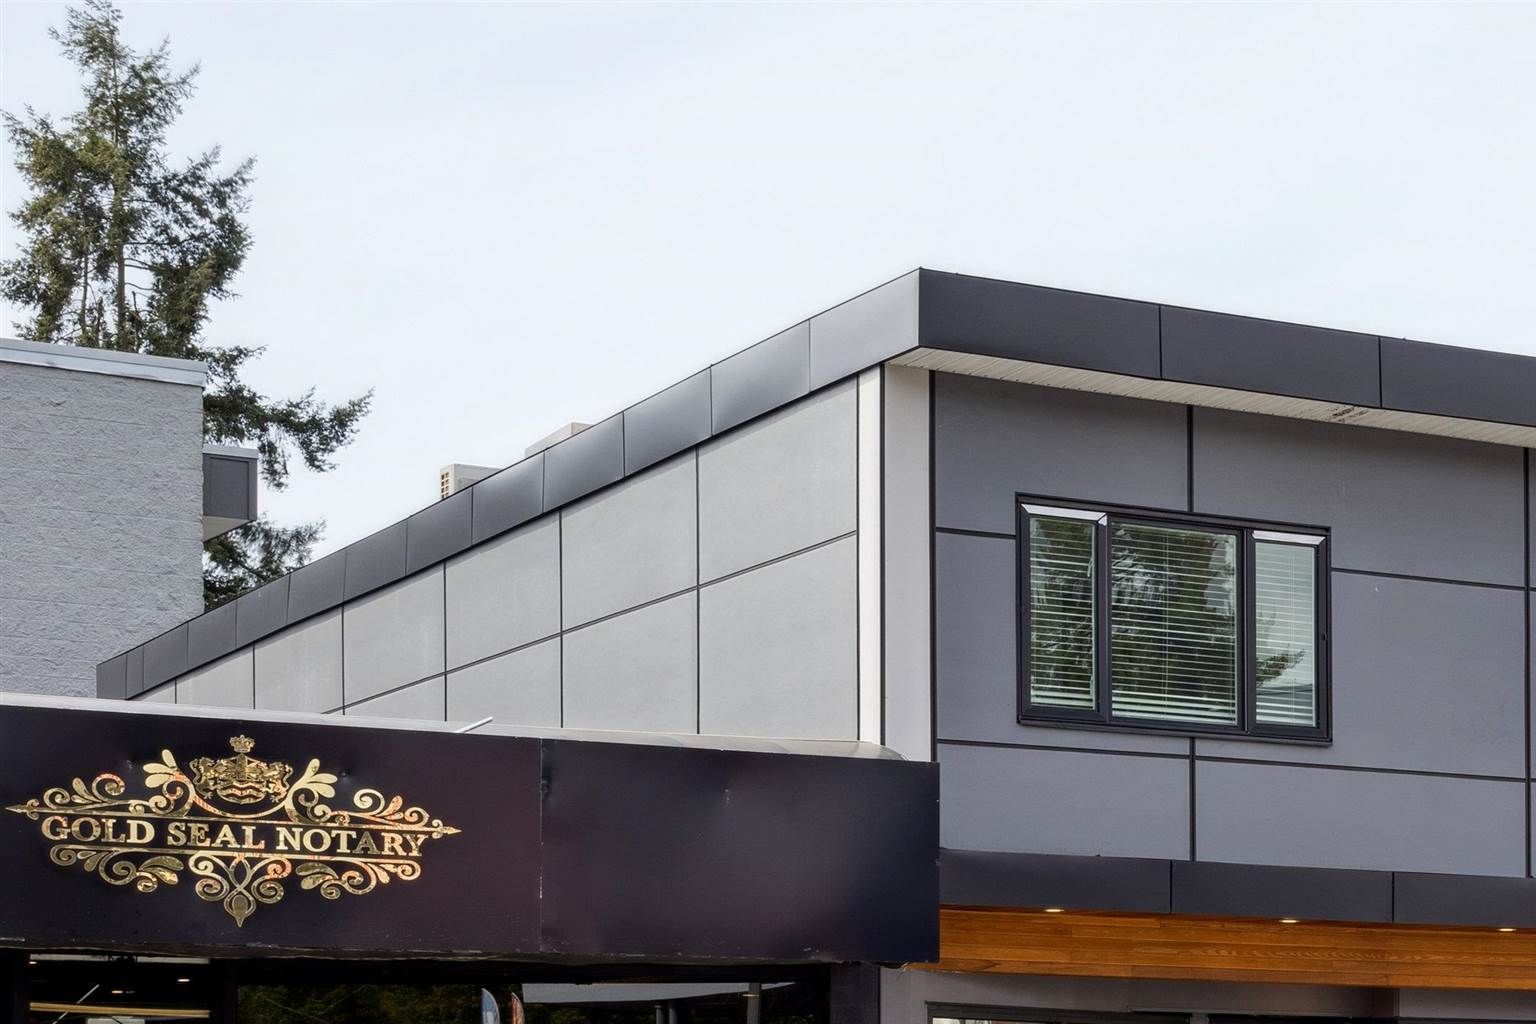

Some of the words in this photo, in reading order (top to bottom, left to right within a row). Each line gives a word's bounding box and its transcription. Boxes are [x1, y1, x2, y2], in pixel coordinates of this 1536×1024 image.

[41, 815, 155, 844] GOLD
[167, 821, 265, 849] SEAL
[275, 826, 428, 857] NOTARY
